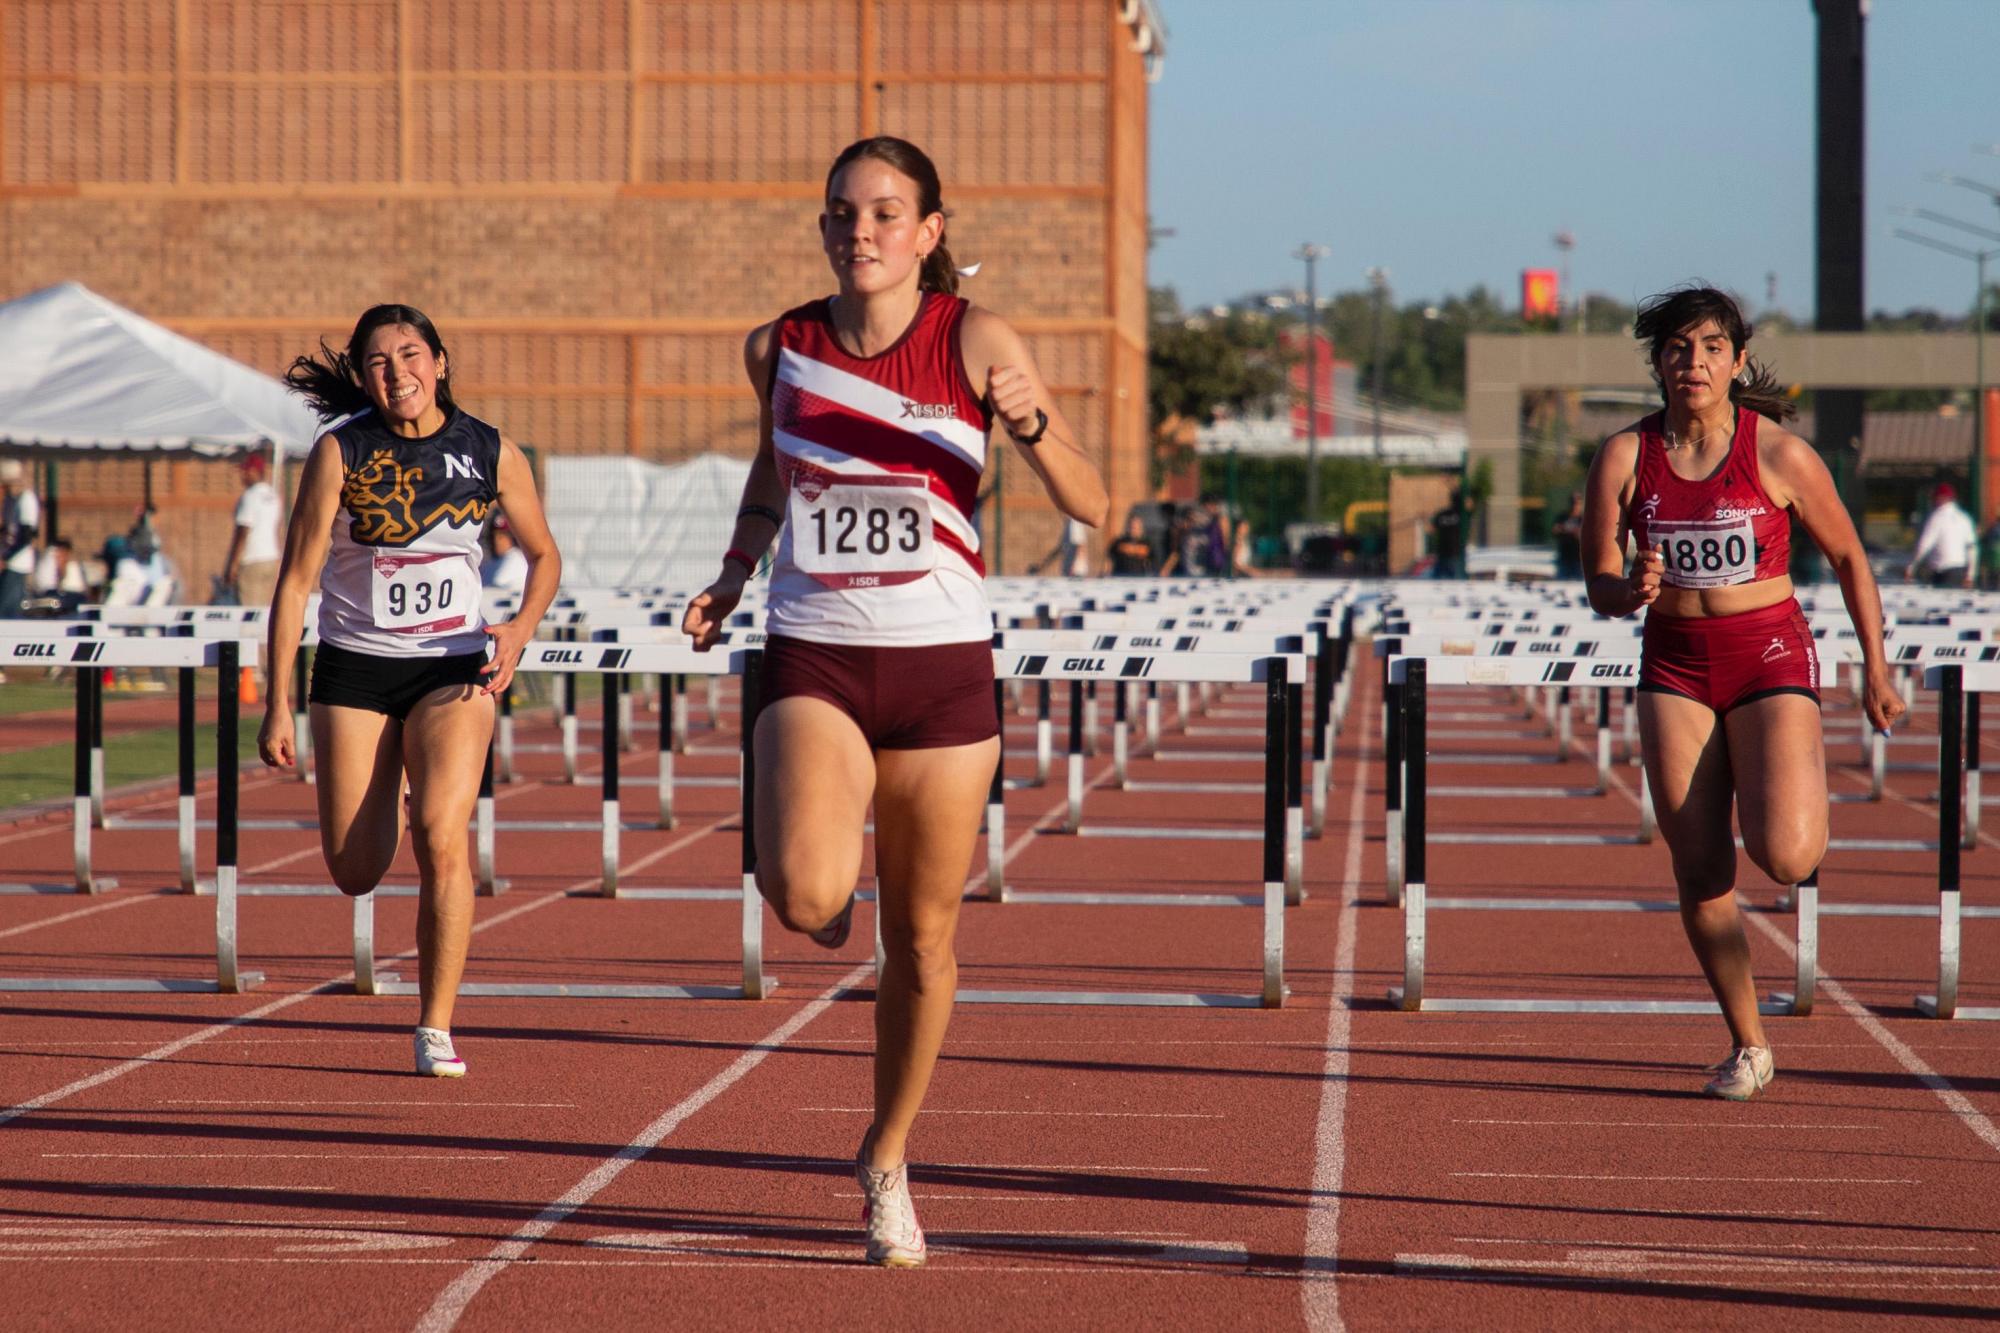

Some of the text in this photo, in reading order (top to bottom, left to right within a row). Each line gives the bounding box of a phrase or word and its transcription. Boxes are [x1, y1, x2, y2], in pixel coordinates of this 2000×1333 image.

[1715, 507, 1767, 519] SONORA
[810, 506, 921, 555] 1283
[1661, 534, 1747, 572] 1880
[856, 576, 880, 587] ISDE
[388, 578, 453, 617] 930
[1130, 636, 1162, 648] GILL
[1528, 641, 1561, 654] GILL
[12, 643, 57, 658] GILL
[540, 650, 583, 664] GILL
[1934, 646, 1968, 658] GILL
[1062, 658, 1106, 672] GILL
[1590, 664, 1634, 677] GILL
